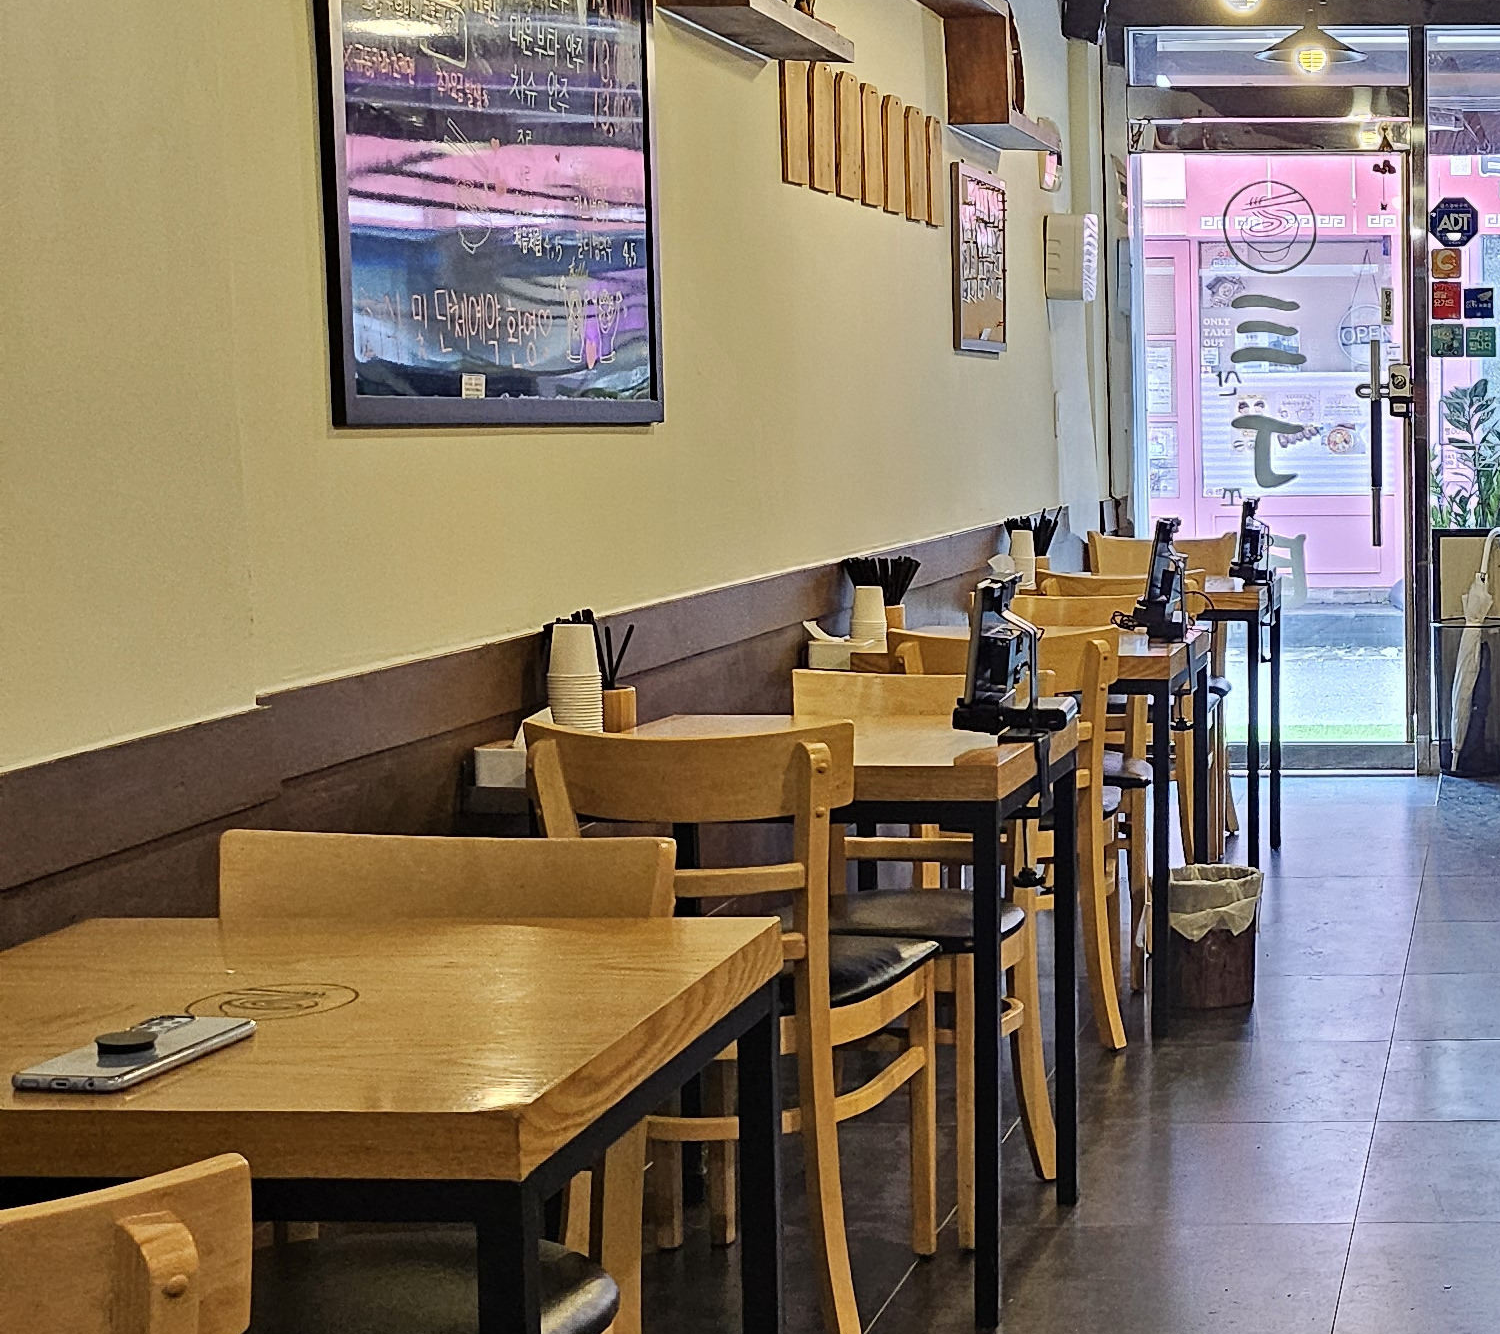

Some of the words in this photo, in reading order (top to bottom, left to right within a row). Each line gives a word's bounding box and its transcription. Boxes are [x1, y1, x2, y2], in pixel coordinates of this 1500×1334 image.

[508, 63, 539, 110] 차슈
[547, 71, 570, 117] 안주
[1436, 212, 1472, 232] ADT
[433, 287, 502, 366] 단체예약
[1202, 317, 1232, 327] ONLY
[1202, 328, 1232, 337] TAKE
[1202, 338, 1225, 348] OUT
